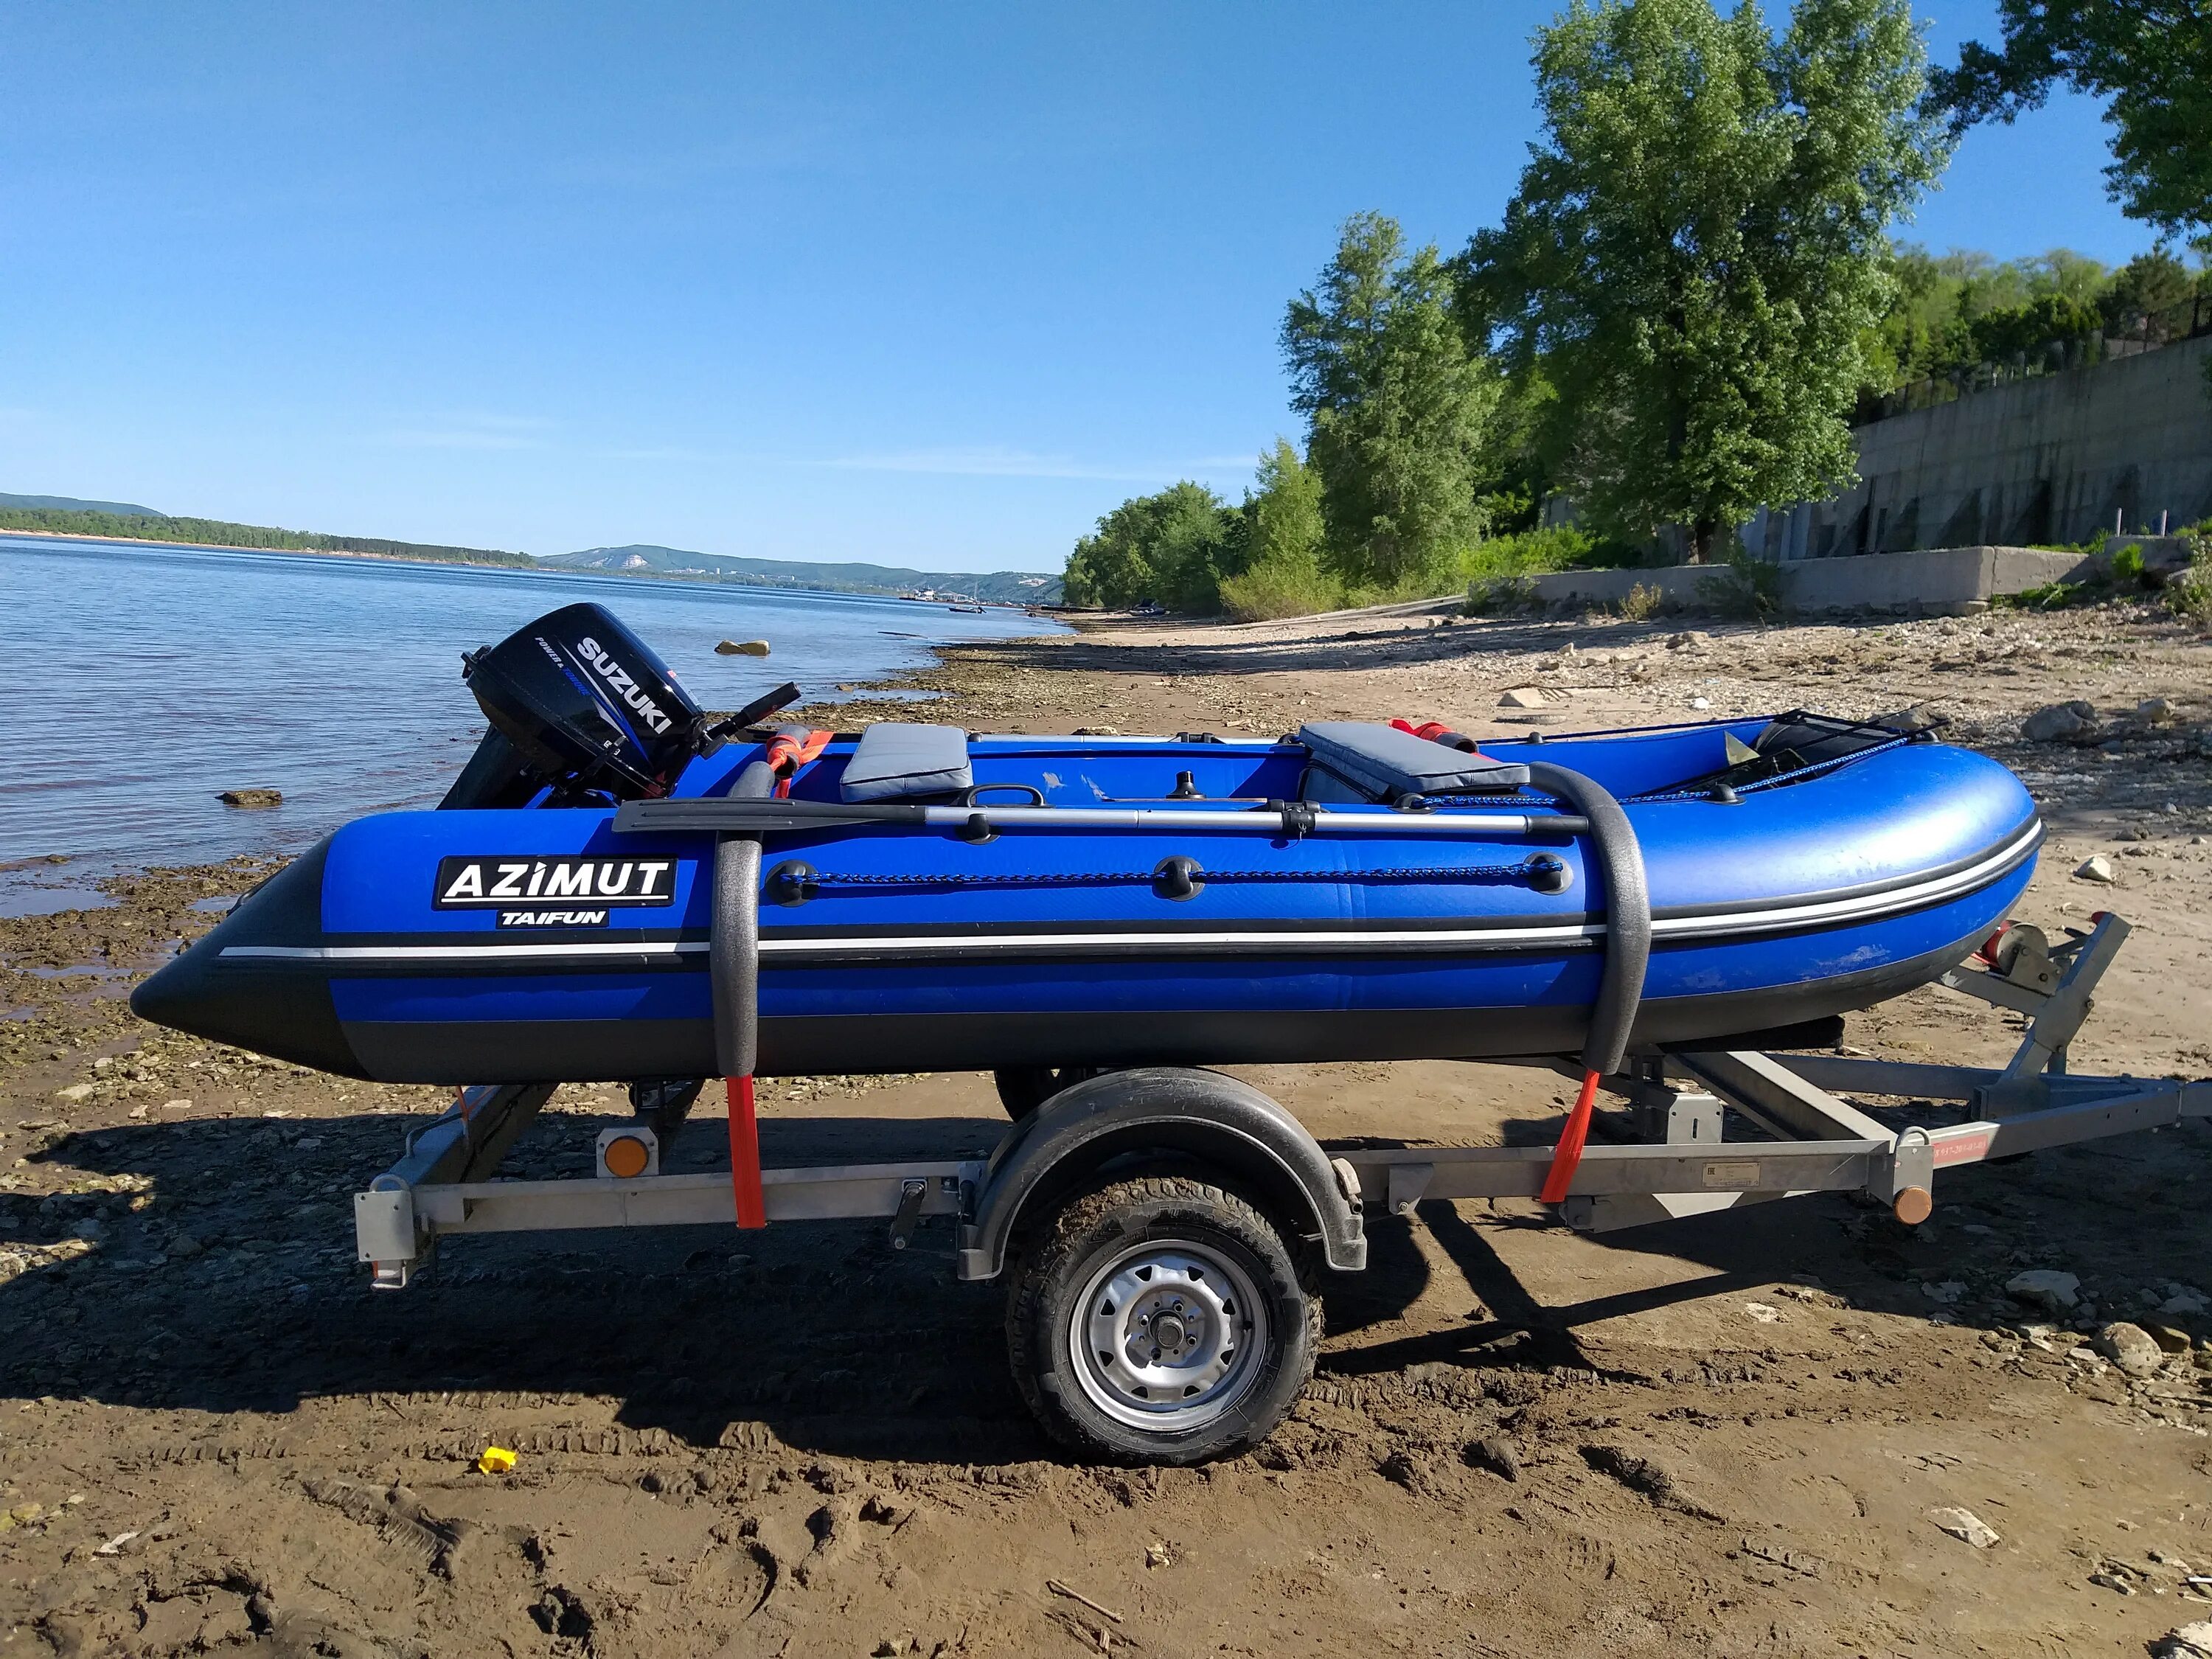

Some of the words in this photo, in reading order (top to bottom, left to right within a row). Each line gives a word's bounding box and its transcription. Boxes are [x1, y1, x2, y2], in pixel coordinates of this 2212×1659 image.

[535, 637, 562, 662] POWER
[577, 637, 672, 734] SUZUKI
[501, 911, 606, 925] TAIFUN
